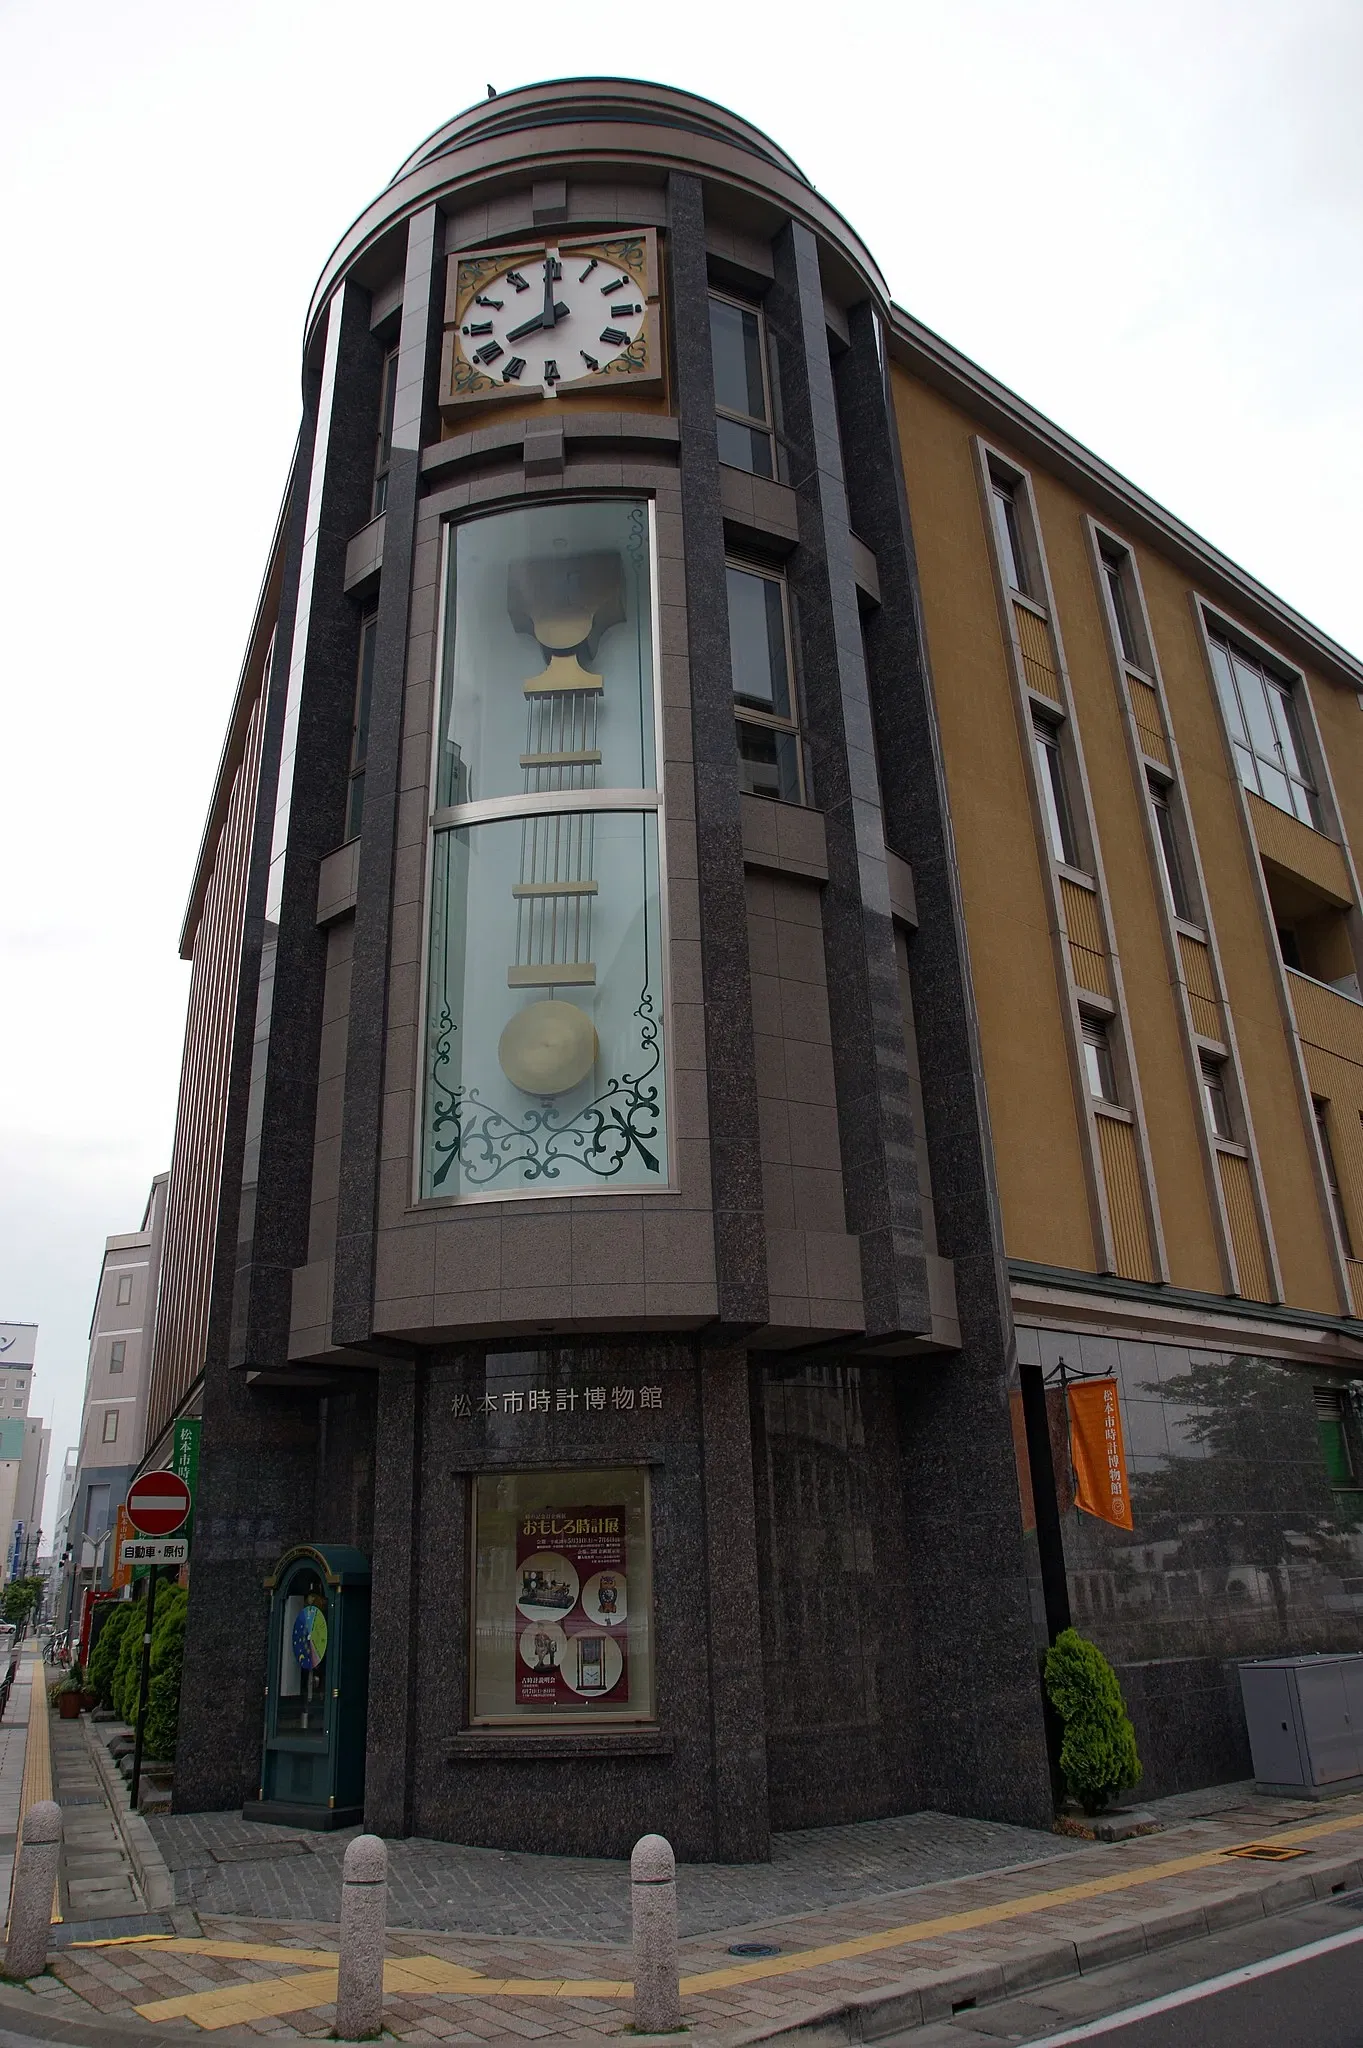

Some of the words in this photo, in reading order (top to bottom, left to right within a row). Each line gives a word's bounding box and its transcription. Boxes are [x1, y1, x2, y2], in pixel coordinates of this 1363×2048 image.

[451, 1385, 663, 1418] 松本市時計博物館
[178, 1428, 192, 1486] 松本市時
[1103, 1390, 1122, 1495] 松本市時計博物館
[523, 1518, 620, 1536] おもしろ時計展
[124, 1545, 185, 1559] 自動車・原付
